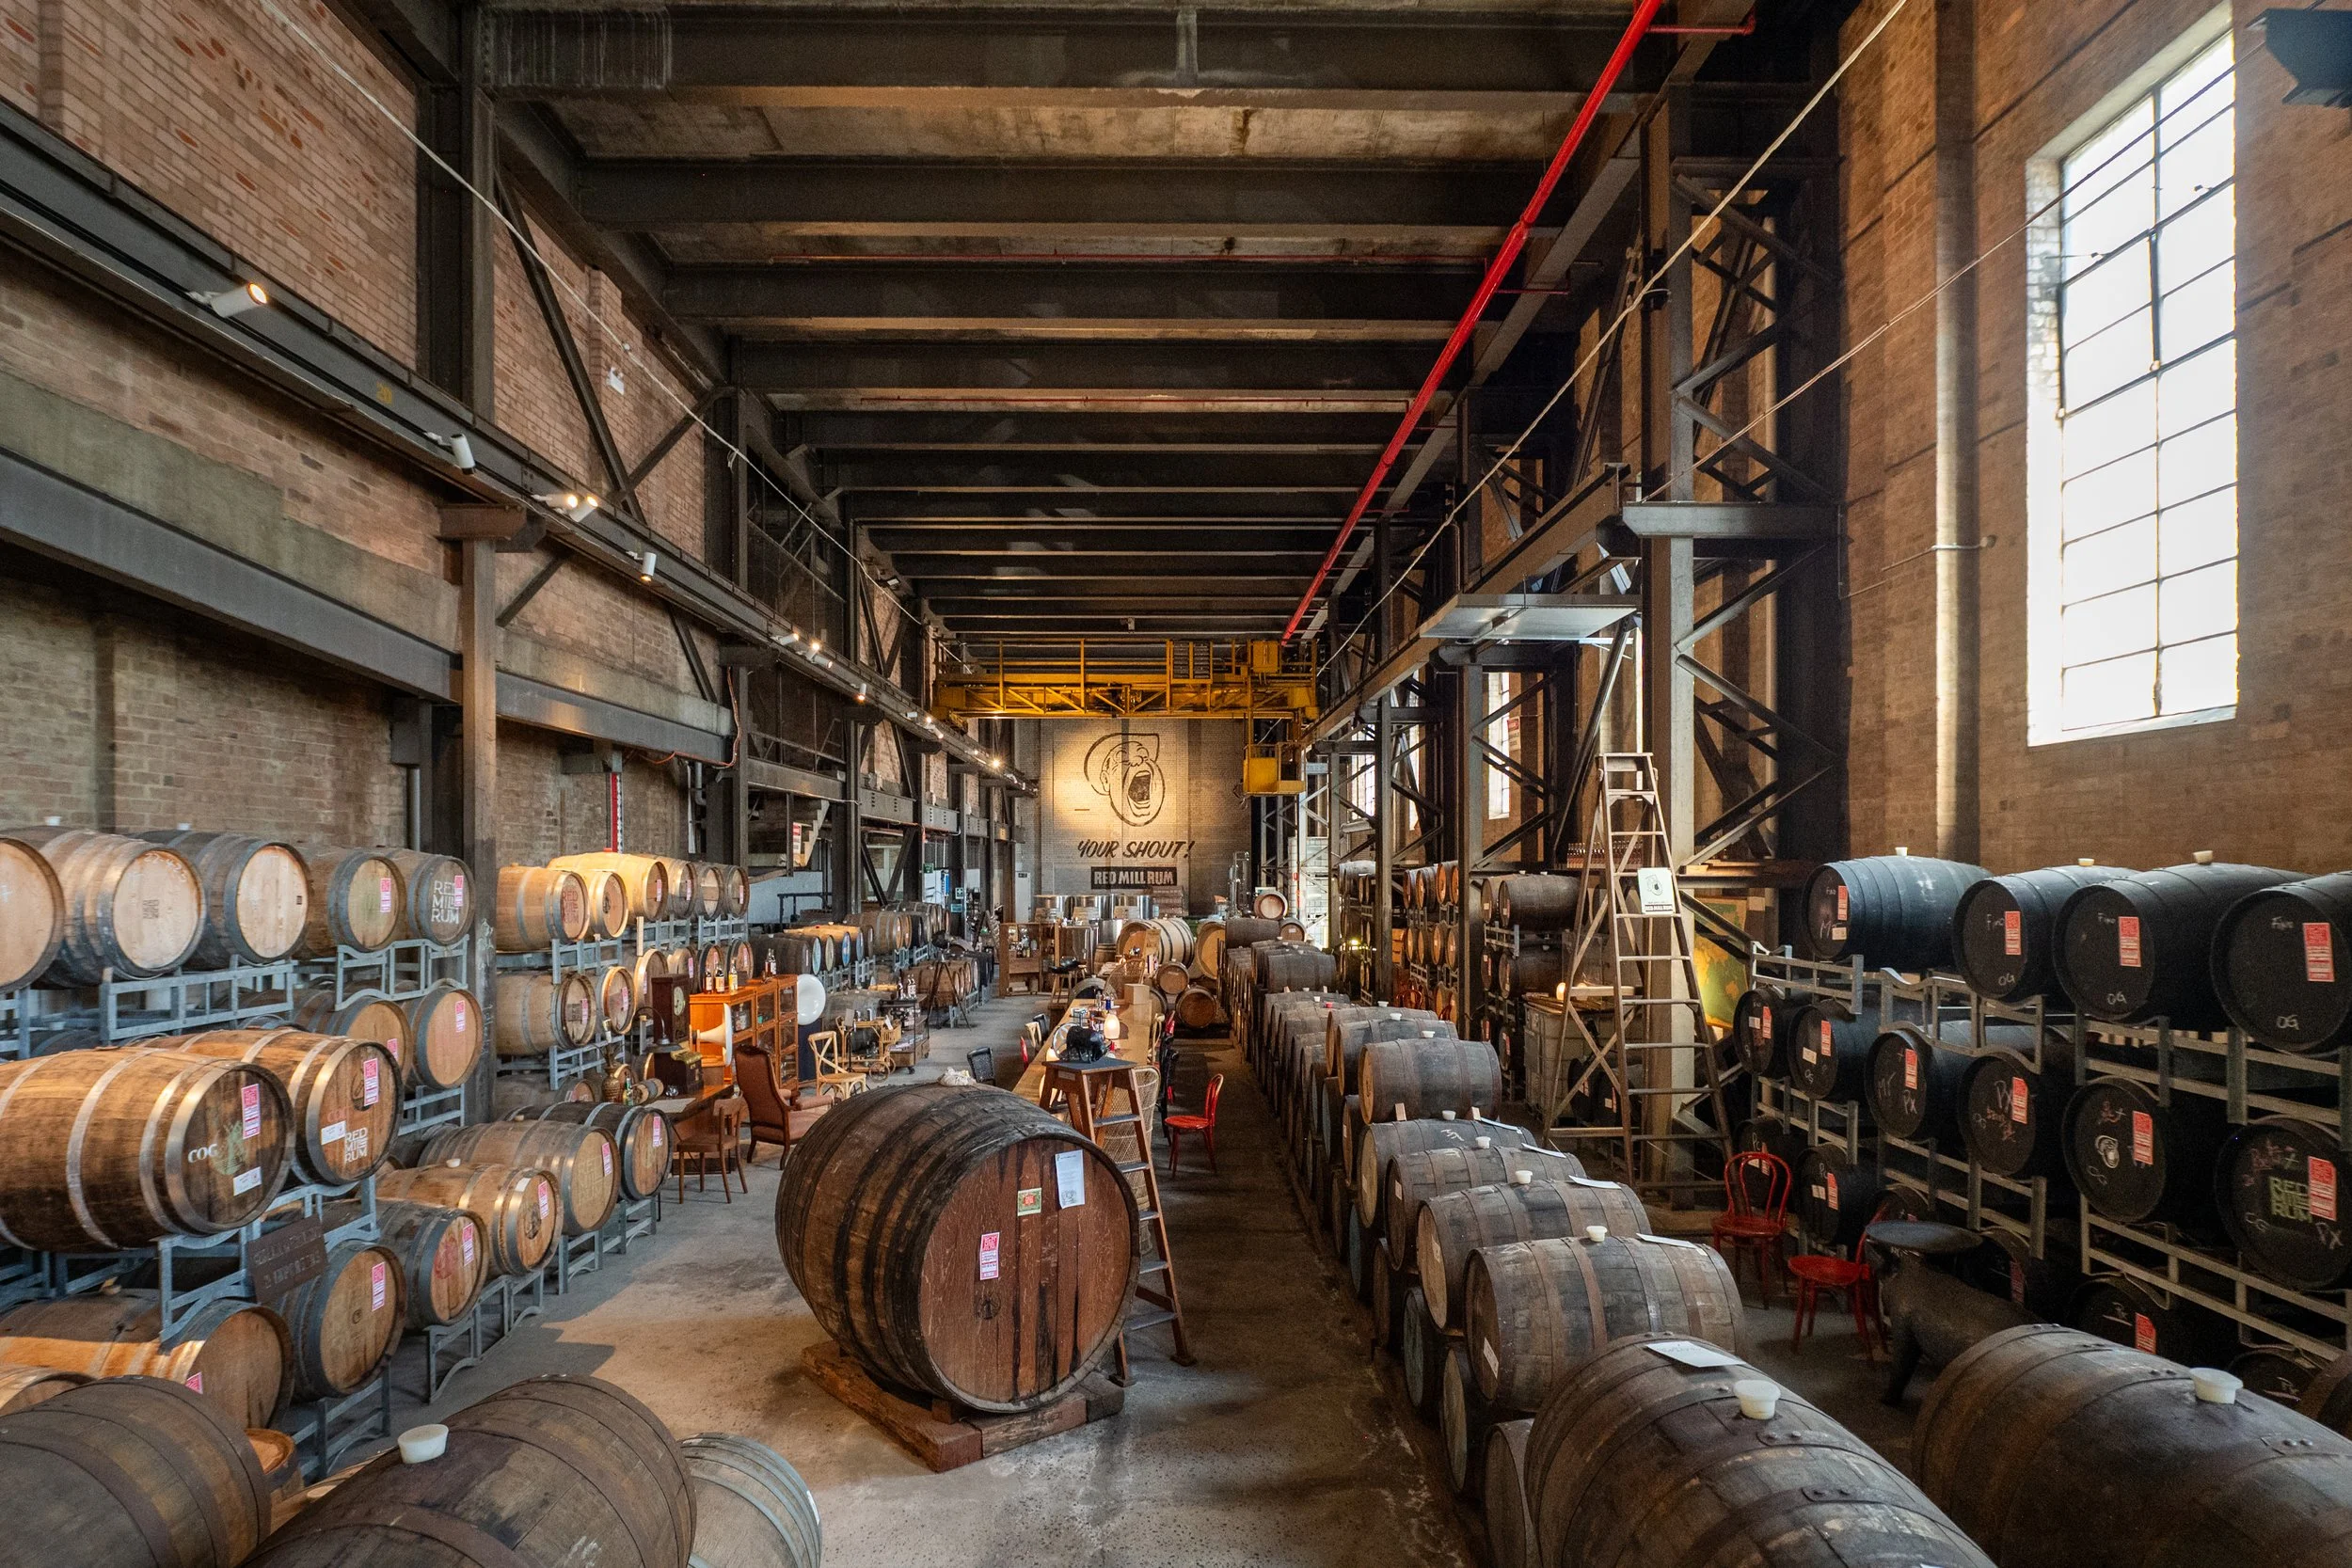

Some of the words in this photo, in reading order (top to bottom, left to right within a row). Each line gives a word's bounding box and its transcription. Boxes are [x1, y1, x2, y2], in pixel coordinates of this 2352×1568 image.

[1078, 839, 1120, 858] YOUR
[1122, 840, 1195, 859] SHOUT!
[1094, 871, 1117, 884] RED
[1118, 871, 1147, 884] MILL
[1147, 871, 1174, 884] RUM
[431, 909, 459, 925] RUM
[345, 1127, 368, 1143] RED
[344, 1148, 368, 1164] RUM
[2271, 1202, 2313, 1223] RUM
